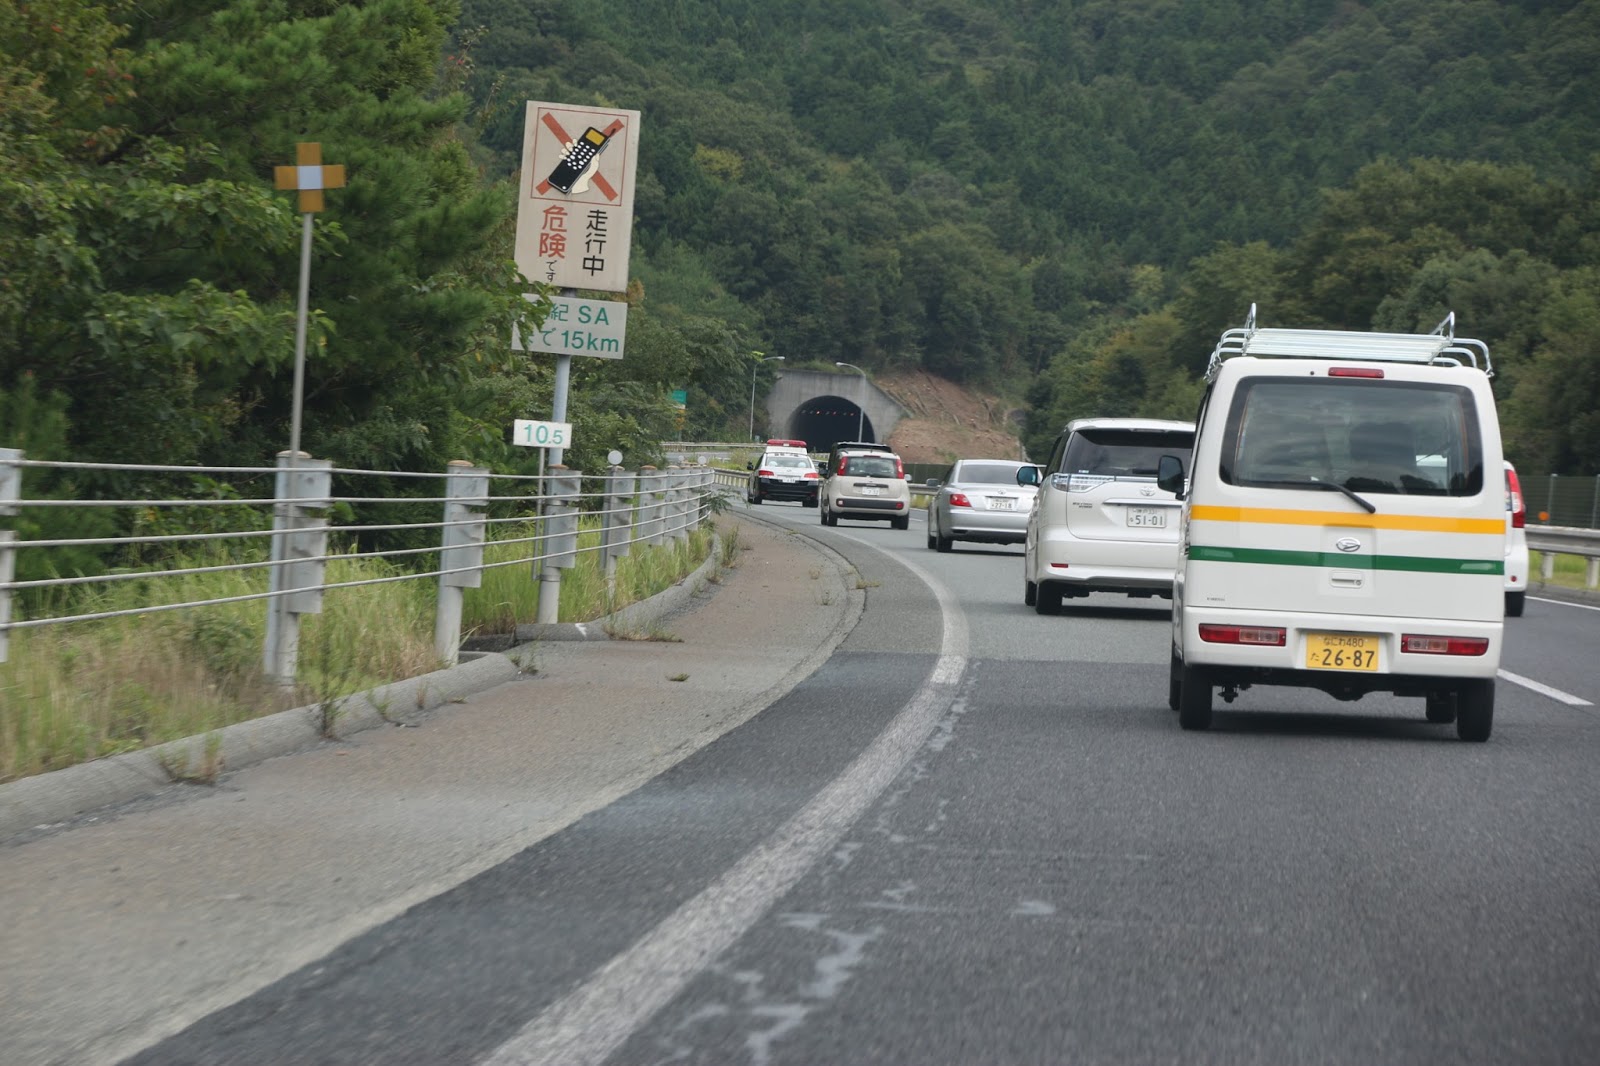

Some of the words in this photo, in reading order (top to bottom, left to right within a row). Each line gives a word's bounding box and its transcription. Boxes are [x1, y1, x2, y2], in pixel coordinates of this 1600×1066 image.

[539, 205, 568, 282] 危険です
[582, 209, 608, 276] 走行中
[577, 305, 609, 325] SA
[523, 424, 563, 445] 10.5
[1135, 515, 1163, 526] 51-01
[1322, 648, 1375, 668] 26-87
